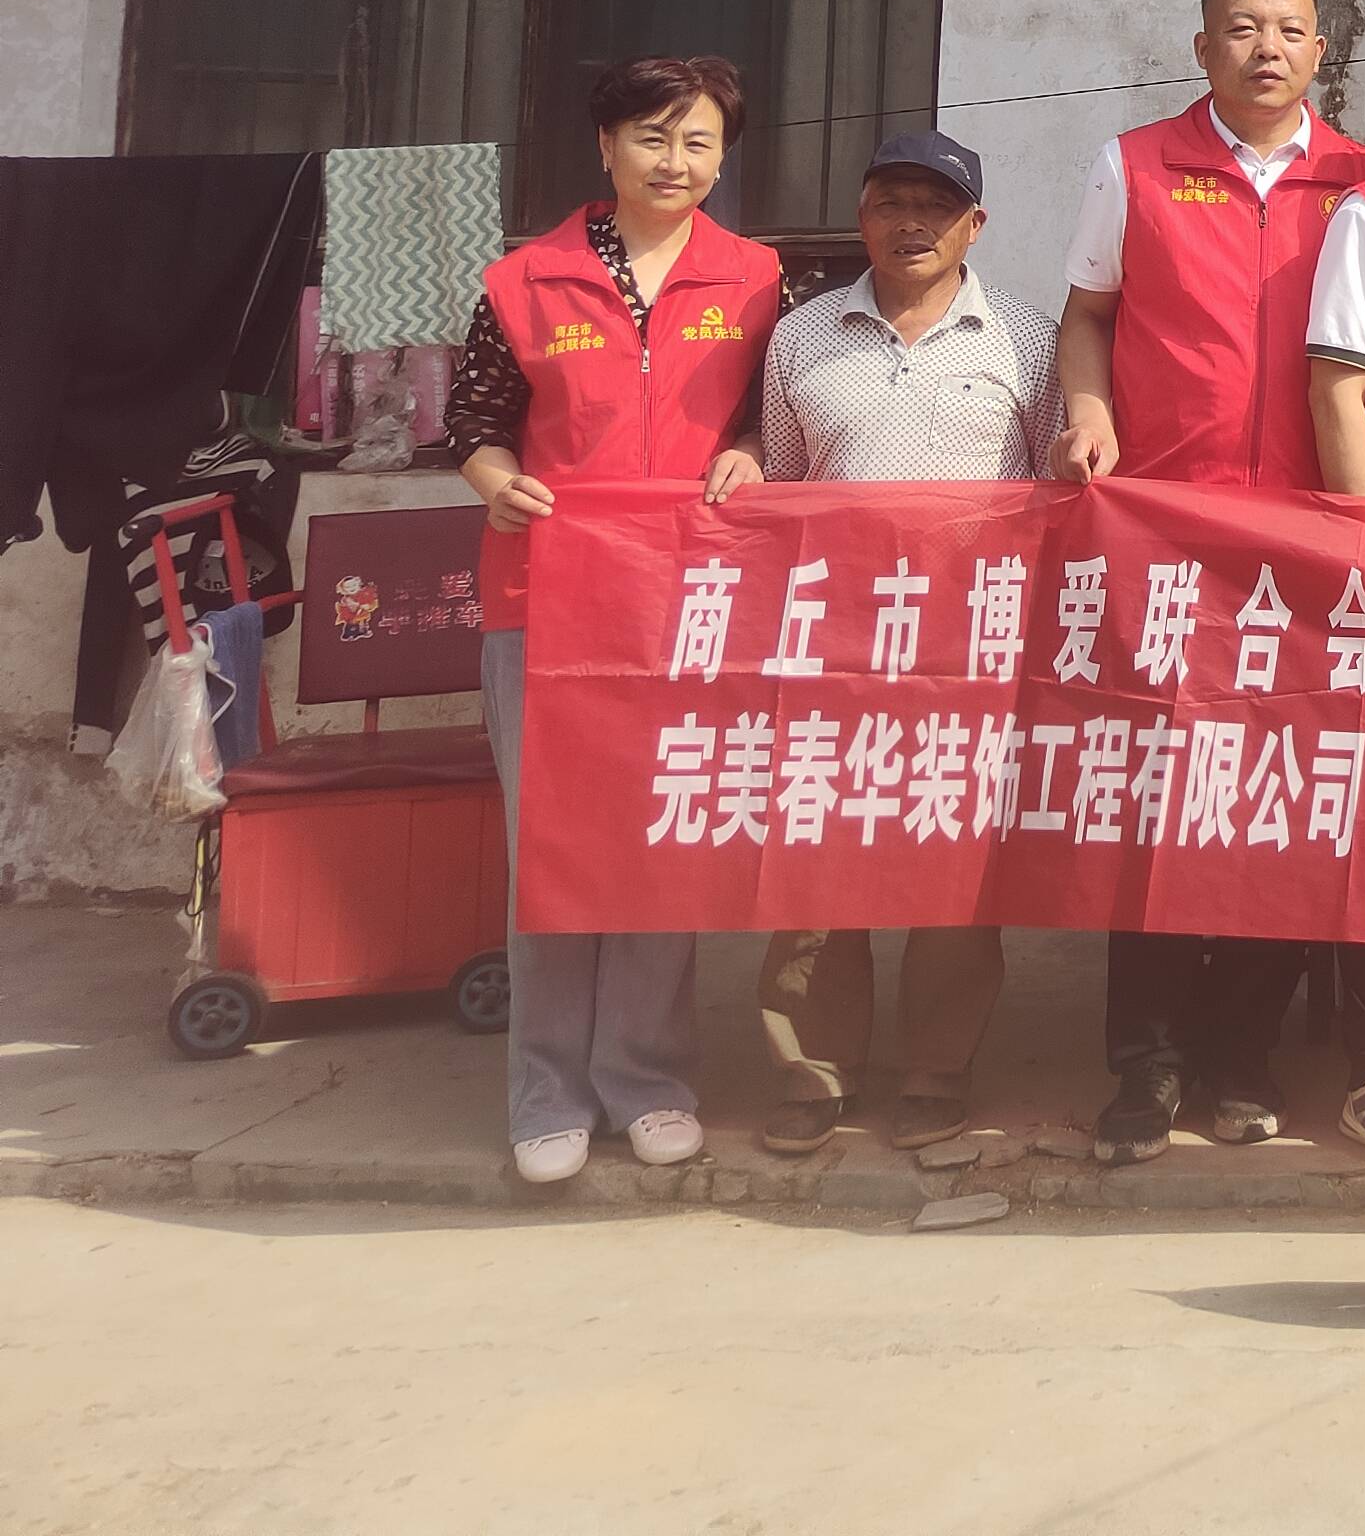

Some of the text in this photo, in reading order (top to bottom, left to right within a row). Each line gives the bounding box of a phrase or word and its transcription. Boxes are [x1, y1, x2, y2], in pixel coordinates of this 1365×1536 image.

[1183, 175, 1218, 189] 商丘市
[1170, 189, 1230, 204] 博爱联合会
[554, 323, 593, 338] 商丘市
[681, 326, 745, 341] 党员先进
